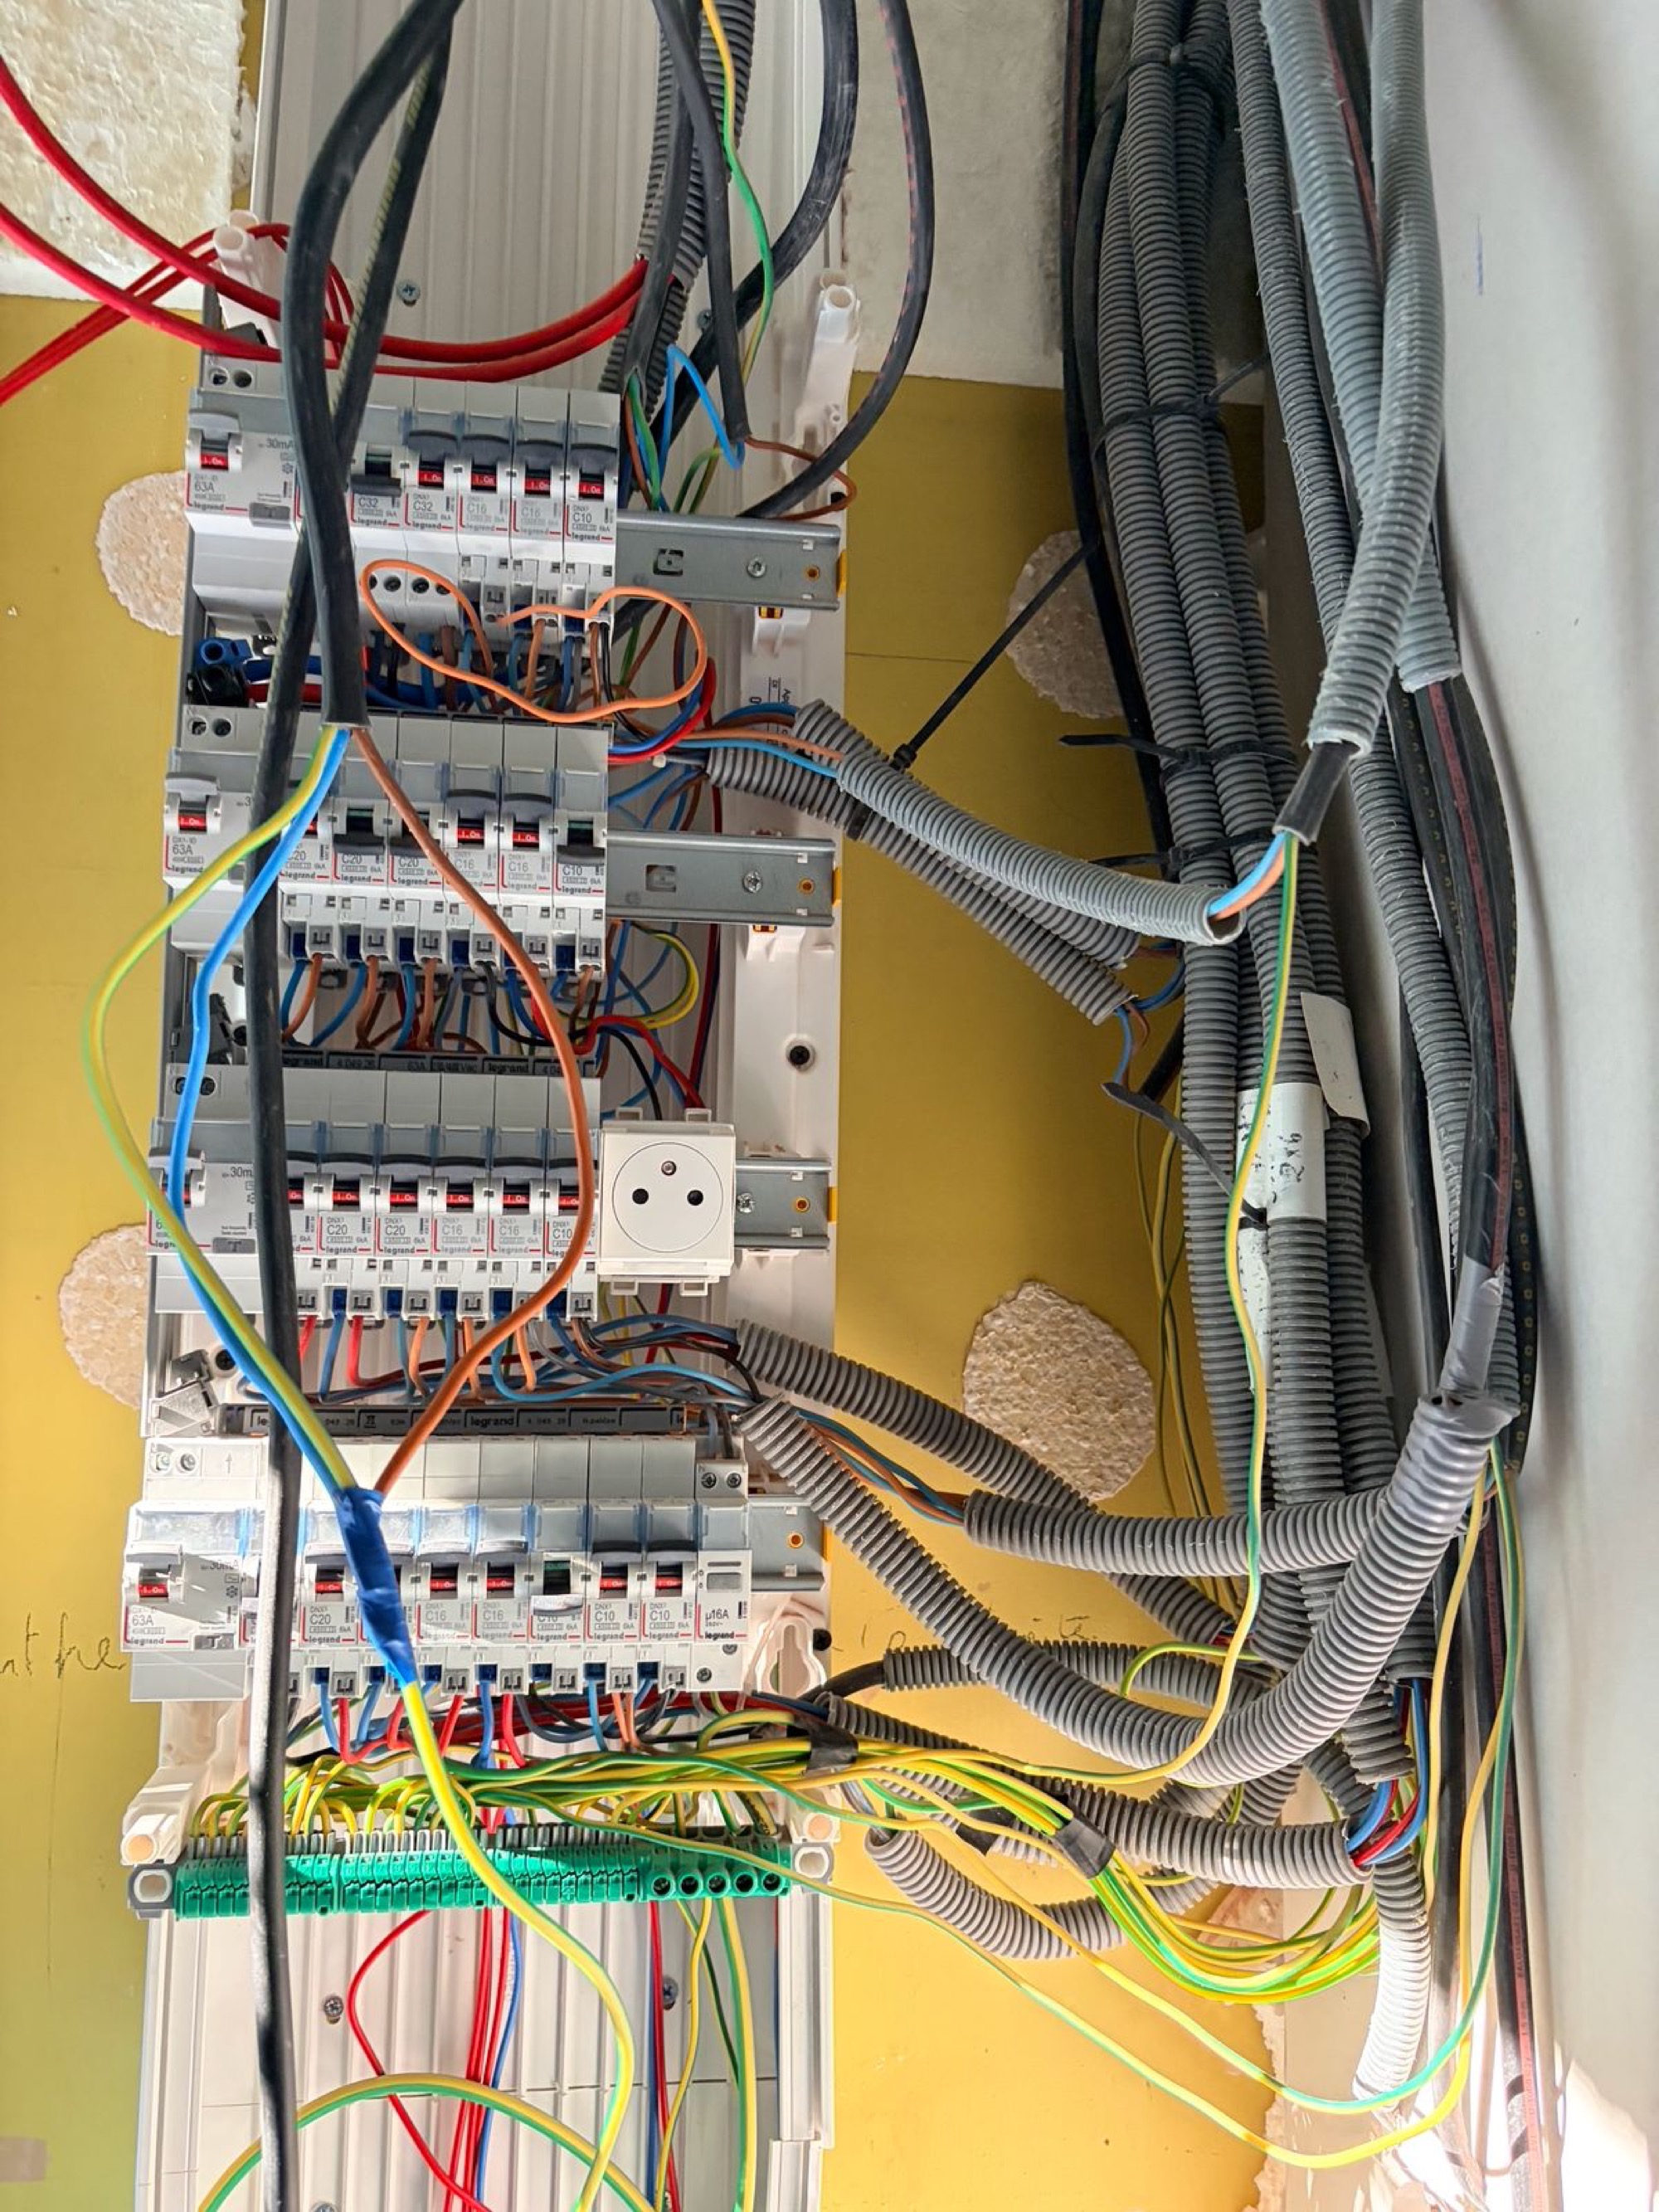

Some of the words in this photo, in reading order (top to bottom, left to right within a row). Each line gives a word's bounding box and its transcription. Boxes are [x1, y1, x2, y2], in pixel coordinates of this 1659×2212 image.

[358, 498, 378, 508] C32
[413, 502, 434, 512] C32
[572, 513, 592, 524] C10
[572, 532, 601, 541] legrand
[172, 845, 193, 855] 63A
[342, 854, 363, 864] C20
[399, 857, 420, 868] C20
[508, 862, 529, 872] C16
[562, 865, 583, 876] C10
[285, 871, 316, 880] legrand
[342, 875, 372, 884] legrand
[327, 1224, 348, 1235] C20
[384, 1224, 406, 1235] C20
[441, 1224, 463, 1235] C16
[499, 1225, 519, 1236] C16
[552, 1228, 573, 1240] C10
[325, 1245, 358, 1255] legrand
[383, 1245, 416, 1255] legrand
[469, 1415, 514, 1428] legrand
[132, 1614, 154, 1626] 63A
[309, 1613, 331, 1625] C20
[425, 1610, 447, 1620] C16
[483, 1610, 504, 1620] C16
[594, 1610, 616, 1622] C10
[649, 1610, 670, 1621] C10
[309, 1635, 340, 1644] legrand
[537, 1633, 567, 1642] legrand
[594, 1632, 625, 1641] legrand
[649, 1631, 679, 1641] legrand
[704, 1631, 735, 1641] legrand
[130, 1637, 165, 1646] legrand
